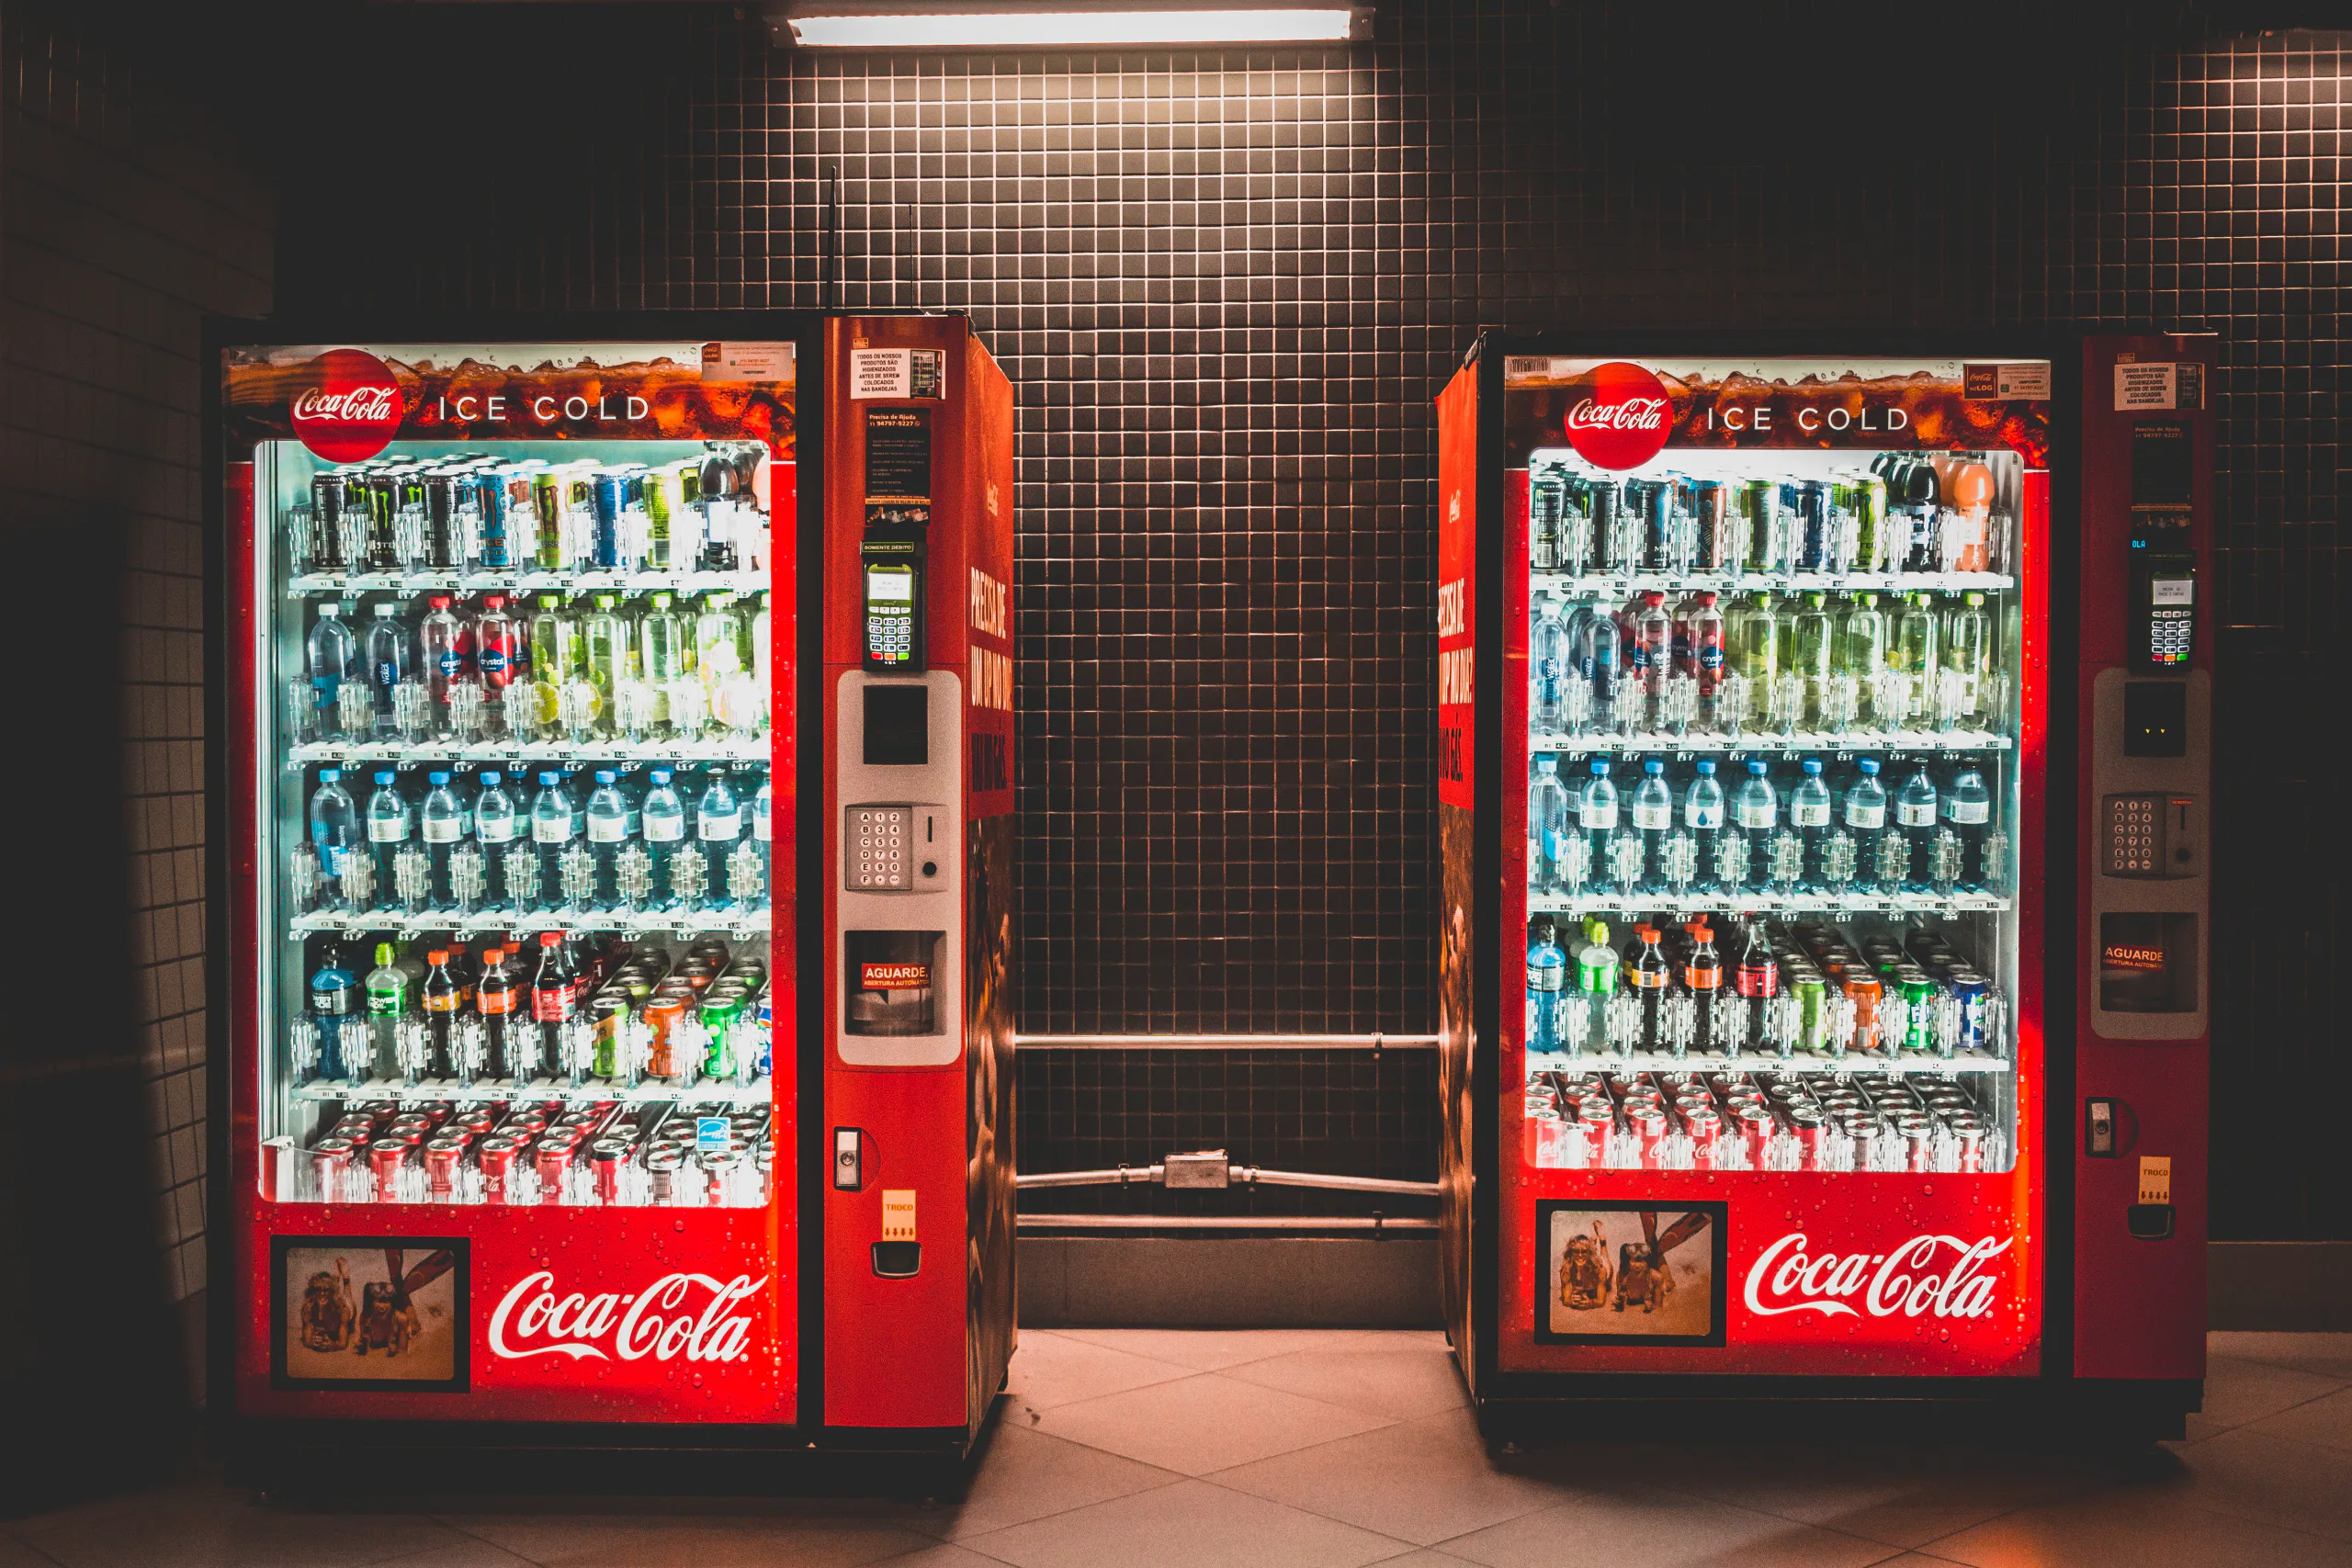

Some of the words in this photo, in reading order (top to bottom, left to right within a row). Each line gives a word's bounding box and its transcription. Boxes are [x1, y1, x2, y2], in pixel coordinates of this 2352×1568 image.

[293, 386, 398, 422] Coca-Cola
[439, 396, 507, 421] ICE
[534, 396, 650, 422] COLD
[1567, 398, 1668, 431] Coca-Cola
[1708, 408, 1773, 432] ICE
[1797, 407, 1909, 432] COLD
[971, 565, 997, 637] PRECISA
[997, 580, 1006, 640] DE
[971, 644, 983, 707] UM
[2143, 1168, 2168, 1177] TROCO
[1744, 1233, 2014, 1318] Coca-Cola
[489, 1270, 770, 1362] Coca-Cola
